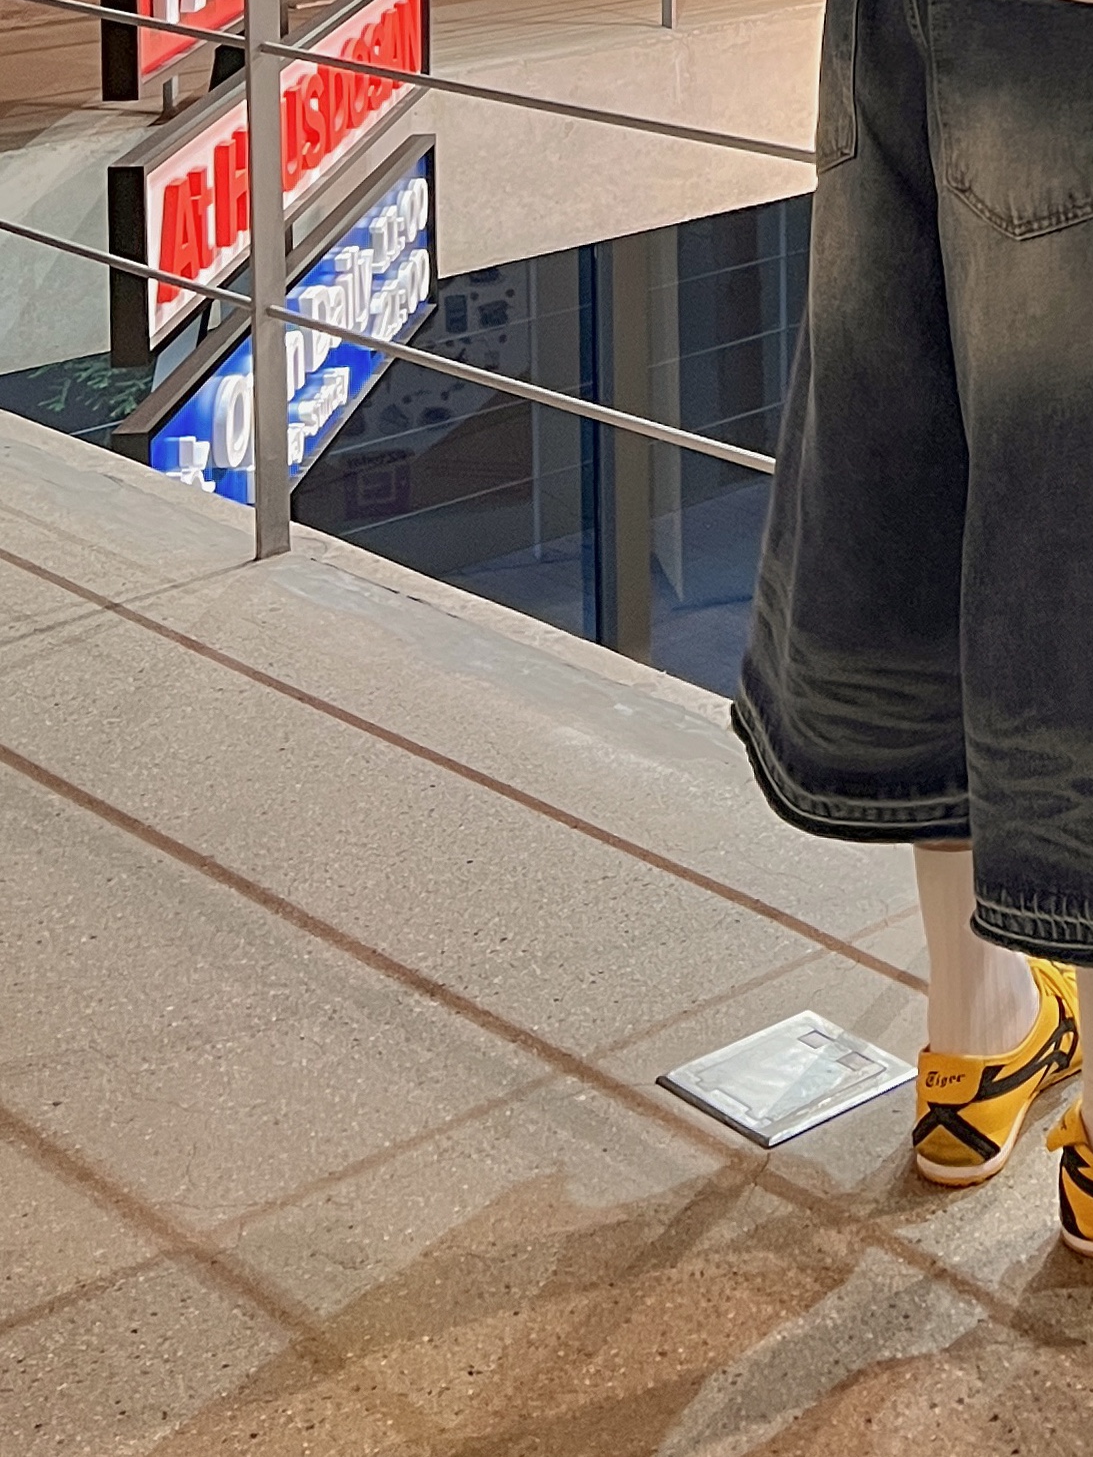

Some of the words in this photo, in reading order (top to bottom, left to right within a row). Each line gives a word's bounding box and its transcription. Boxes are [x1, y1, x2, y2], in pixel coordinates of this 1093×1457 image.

[157, 166, 214, 304] At
[299, 245, 375, 372] Daily
[925, 1071, 966, 1088] Tiger
